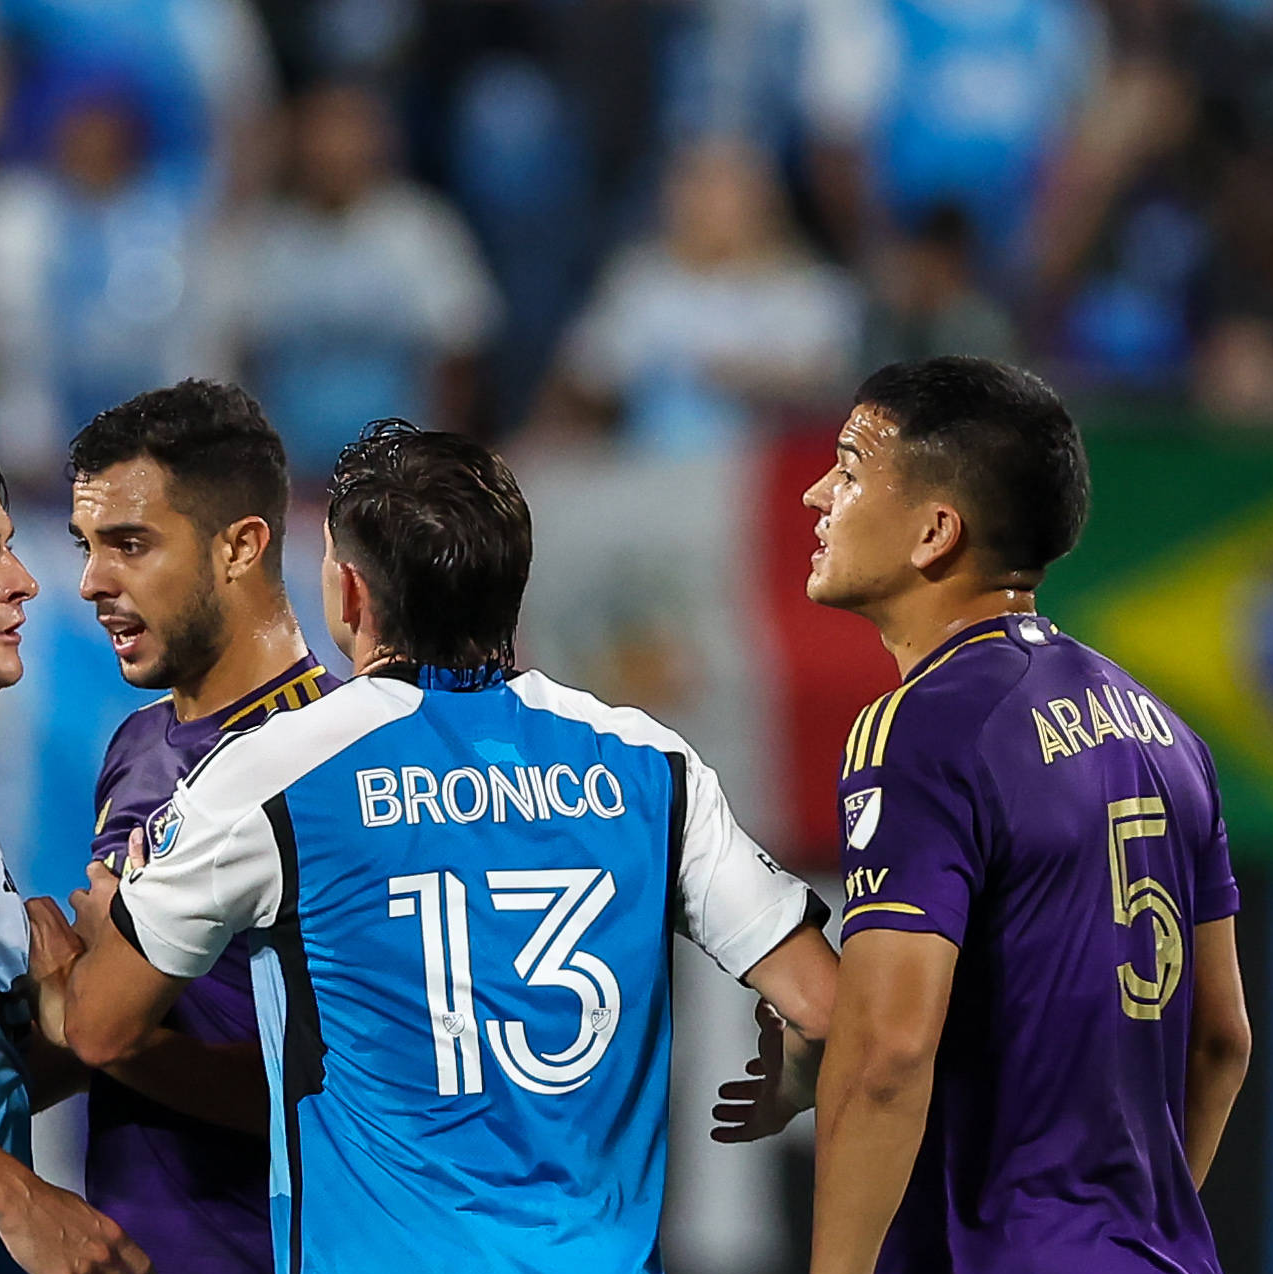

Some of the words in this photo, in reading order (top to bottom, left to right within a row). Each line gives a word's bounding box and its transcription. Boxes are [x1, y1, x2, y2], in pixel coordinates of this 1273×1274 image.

[354, 762, 627, 829] BRONICO
[1030, 684, 1176, 764] ARAUJO
[388, 868, 624, 1097] 13
[1107, 796, 1183, 1021] 5
